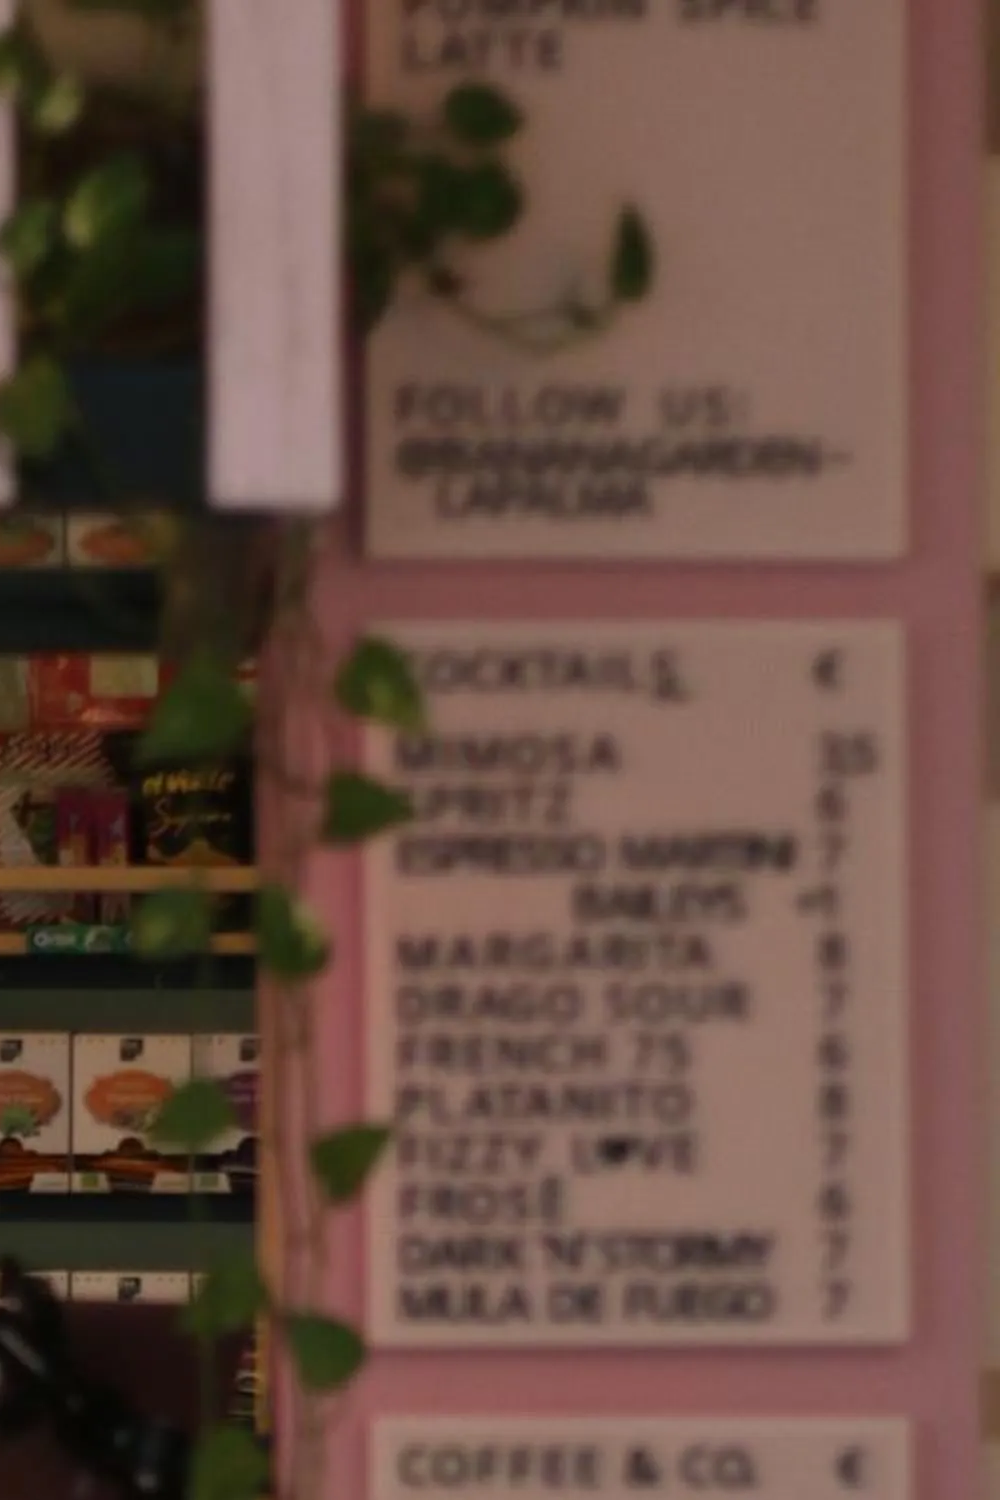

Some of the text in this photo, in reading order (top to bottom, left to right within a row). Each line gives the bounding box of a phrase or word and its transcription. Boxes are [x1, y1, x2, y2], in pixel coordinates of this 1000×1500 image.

[402, 34, 558, 69] LATTE
[393, 388, 626, 422] FOLLOW
[397, 735, 622, 771] MIMOSA
[396, 936, 710, 968] MARGARITA
[397, 987, 582, 1021] DRAGO
[607, 983, 752, 1018] SOUR
[397, 1036, 607, 1068] FRENCH
[636, 1033, 691, 1074] 75
[397, 1084, 692, 1119] PLATANITO
[398, 1134, 540, 1171] FIZZY
[401, 1237, 521, 1269] DARK
[400, 1287, 530, 1318] MULA
[550, 1286, 601, 1318] DE
[624, 1285, 777, 1317] FUEGO
[397, 1447, 600, 1487] COFFEE
